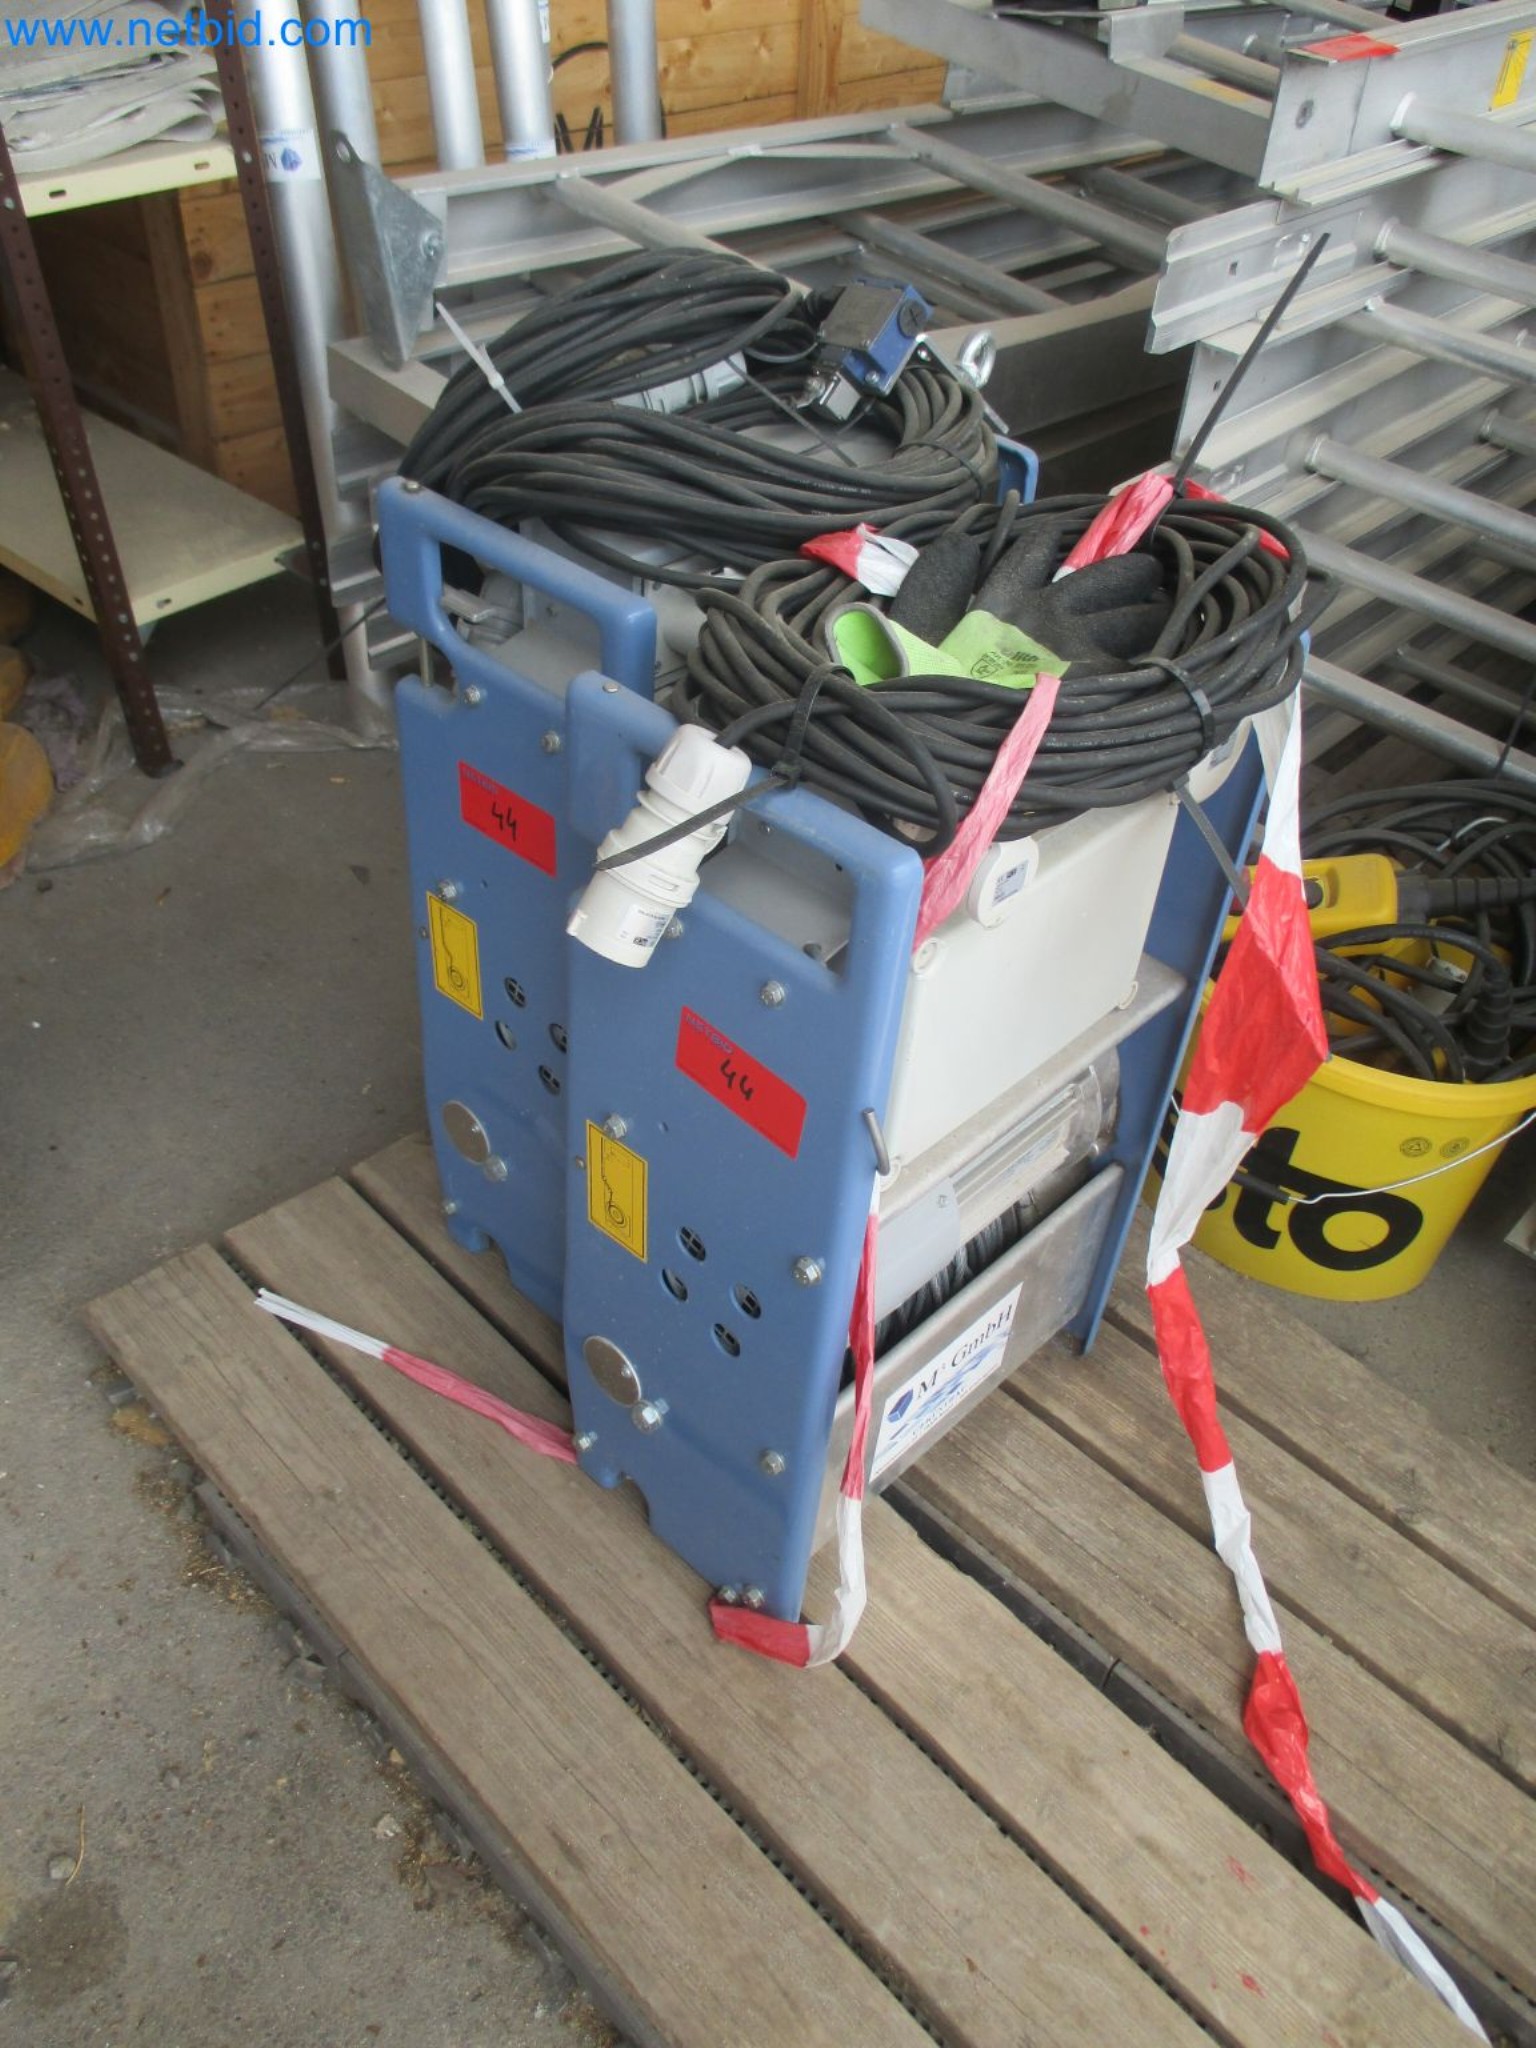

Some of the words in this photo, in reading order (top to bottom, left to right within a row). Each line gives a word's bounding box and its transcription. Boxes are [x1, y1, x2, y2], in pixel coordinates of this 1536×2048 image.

[491, 801, 517, 842] 44
[720, 1058, 754, 1101] 44
[951, 1304, 1013, 1368] GmbH
